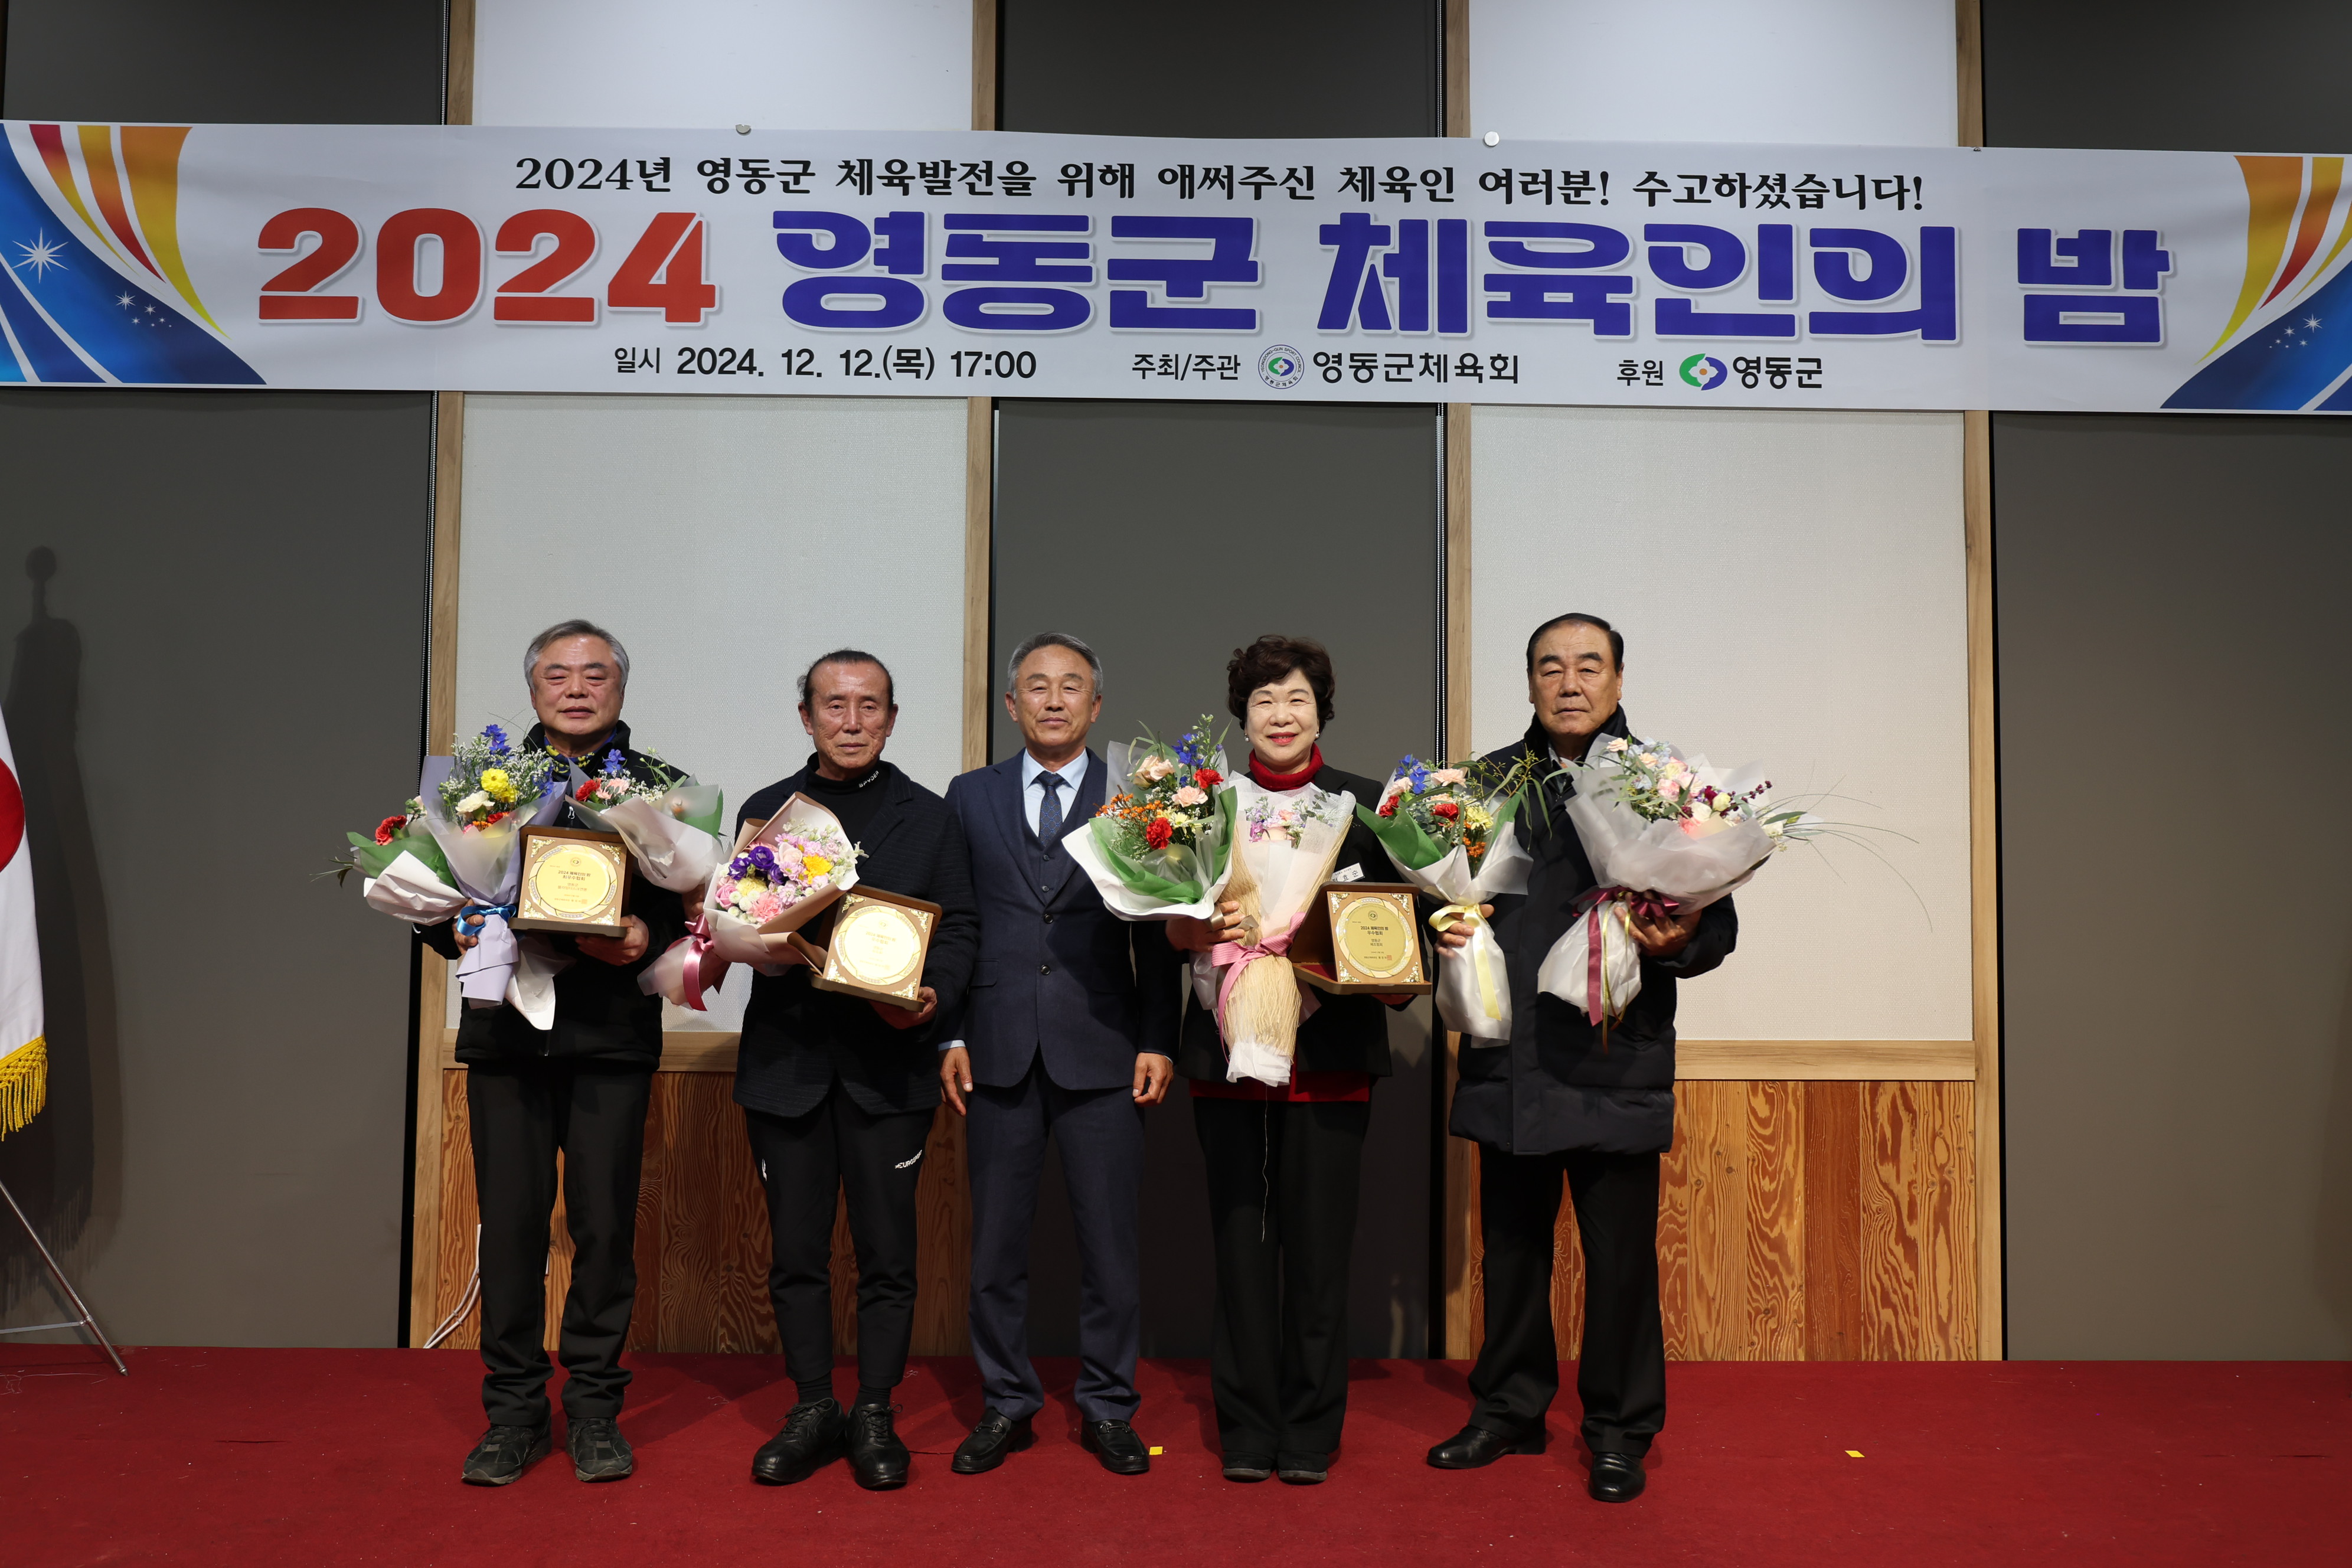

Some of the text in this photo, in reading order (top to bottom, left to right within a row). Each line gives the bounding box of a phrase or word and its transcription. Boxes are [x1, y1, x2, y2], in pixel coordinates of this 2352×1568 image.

[516, 158, 1923, 211] 2024년 영동군 체육발전을 위해 애써주신 체육인 여러분! 수고하셨습니다!
[259, 210, 2169, 342] 2024 영동군 체육인의 밤
[615, 344, 1037, 381] 일시 2024. 12. 12.(목) 17:00
[1132, 353, 1241, 383] 주최/주관
[1261, 347, 1283, 373] YEONGDONG-GUN
[1284, 348, 1297, 357] SPORT
[1313, 351, 1518, 384] 영동군체육회
[1617, 357, 1822, 390] 후원 영동군
[859, 770, 880, 788] SPYDER
